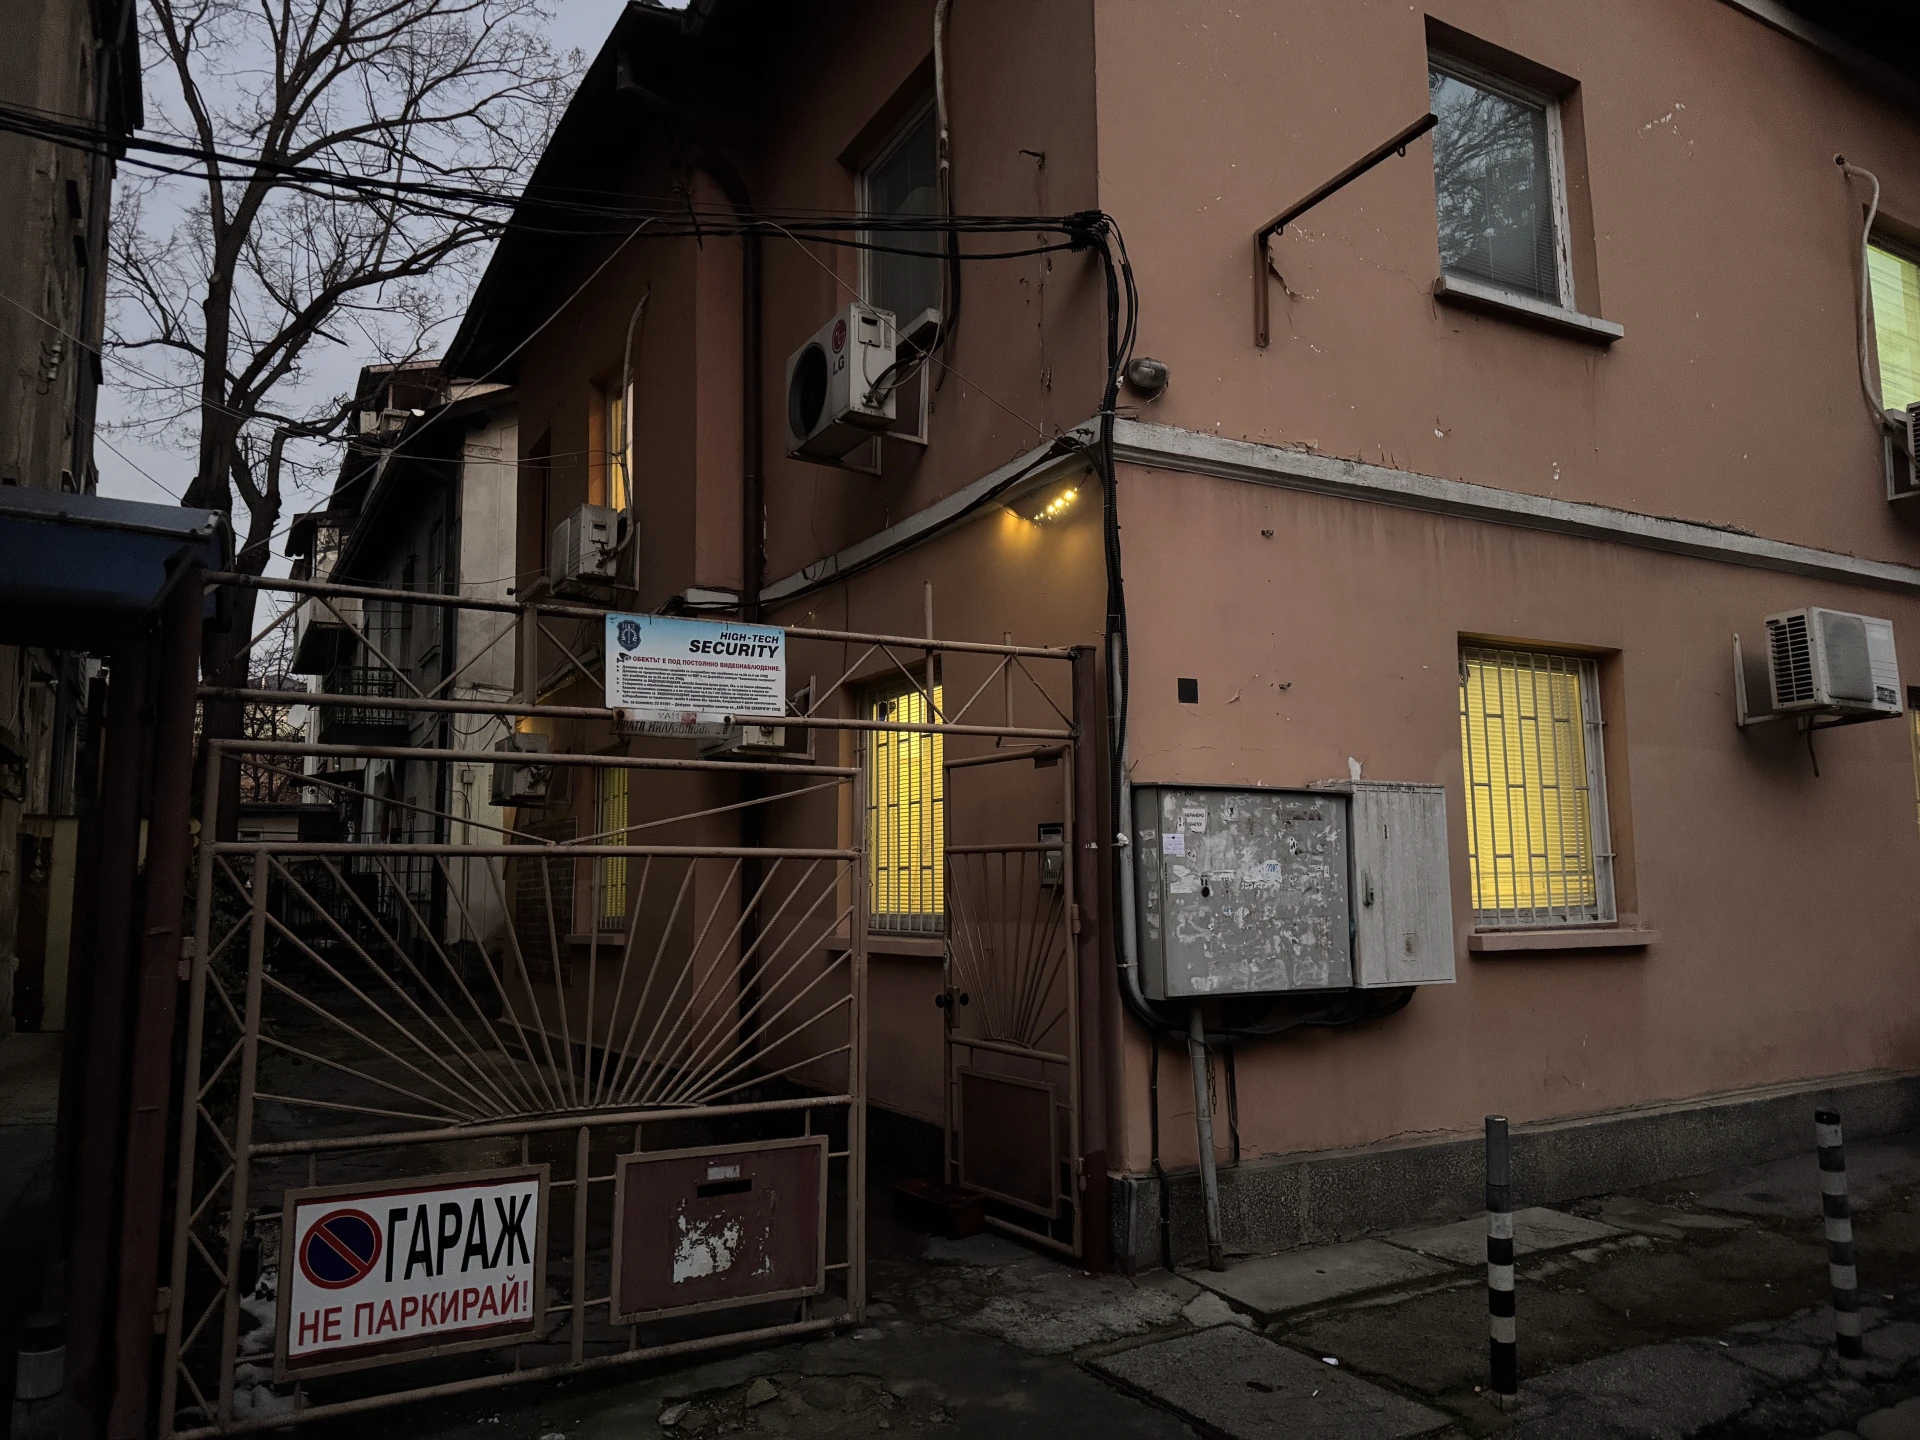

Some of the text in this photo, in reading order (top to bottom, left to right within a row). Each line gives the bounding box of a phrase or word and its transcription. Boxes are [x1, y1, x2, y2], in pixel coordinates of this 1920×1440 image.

[832, 354, 845, 376] LG
[720, 632, 779, 644] HIGH-TECH
[689, 640, 779, 659] SECURITY
[632, 655, 660, 664] ОБЕКТЪТ
[667, 658, 681, 666] ПОД
[682, 659, 719, 668] ПОСТОЯННО
[385, 1193, 532, 1284] ГАРАЖ
[298, 1275, 529, 1346] НЕ ПАРКИРАЙ!
